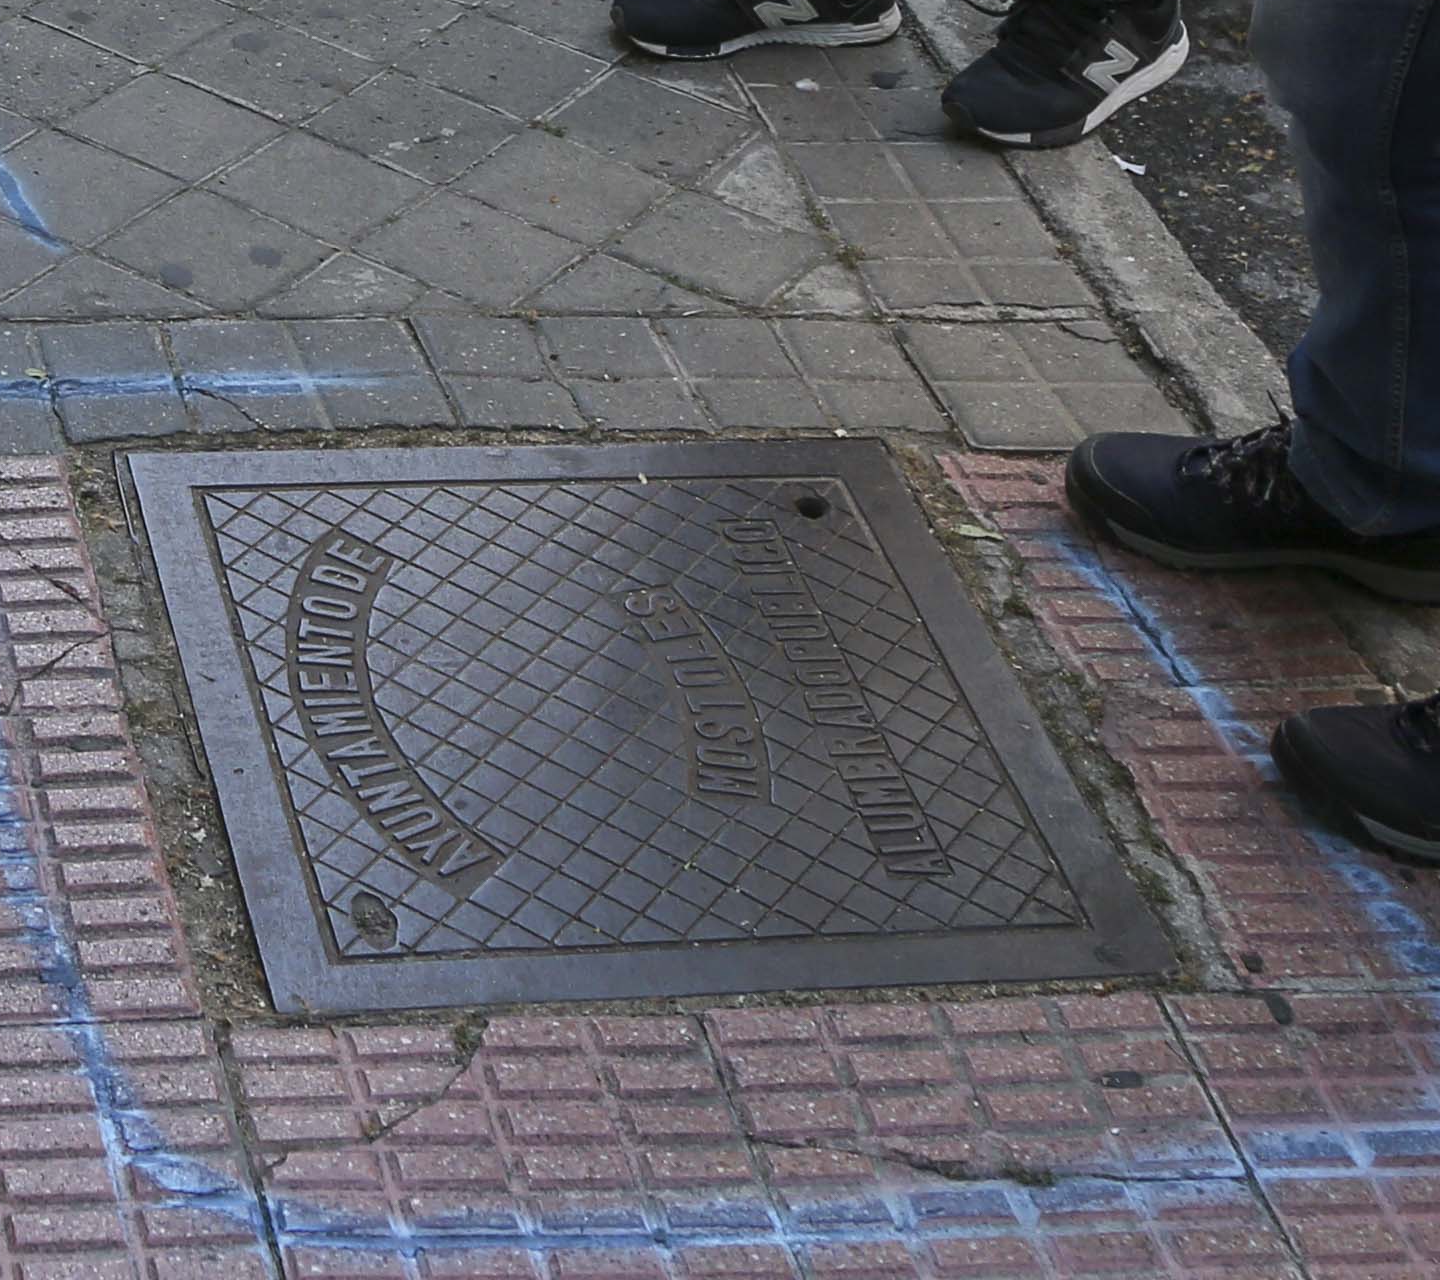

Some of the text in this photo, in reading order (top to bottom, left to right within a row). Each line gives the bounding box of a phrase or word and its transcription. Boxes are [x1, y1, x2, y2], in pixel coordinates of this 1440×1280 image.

[297, 538, 496, 878] AYUNTAMIENTO DE
[623, 589, 763, 799] MOSTOLES
[722, 521, 953, 876] ALUMBRADO PUBLICO
